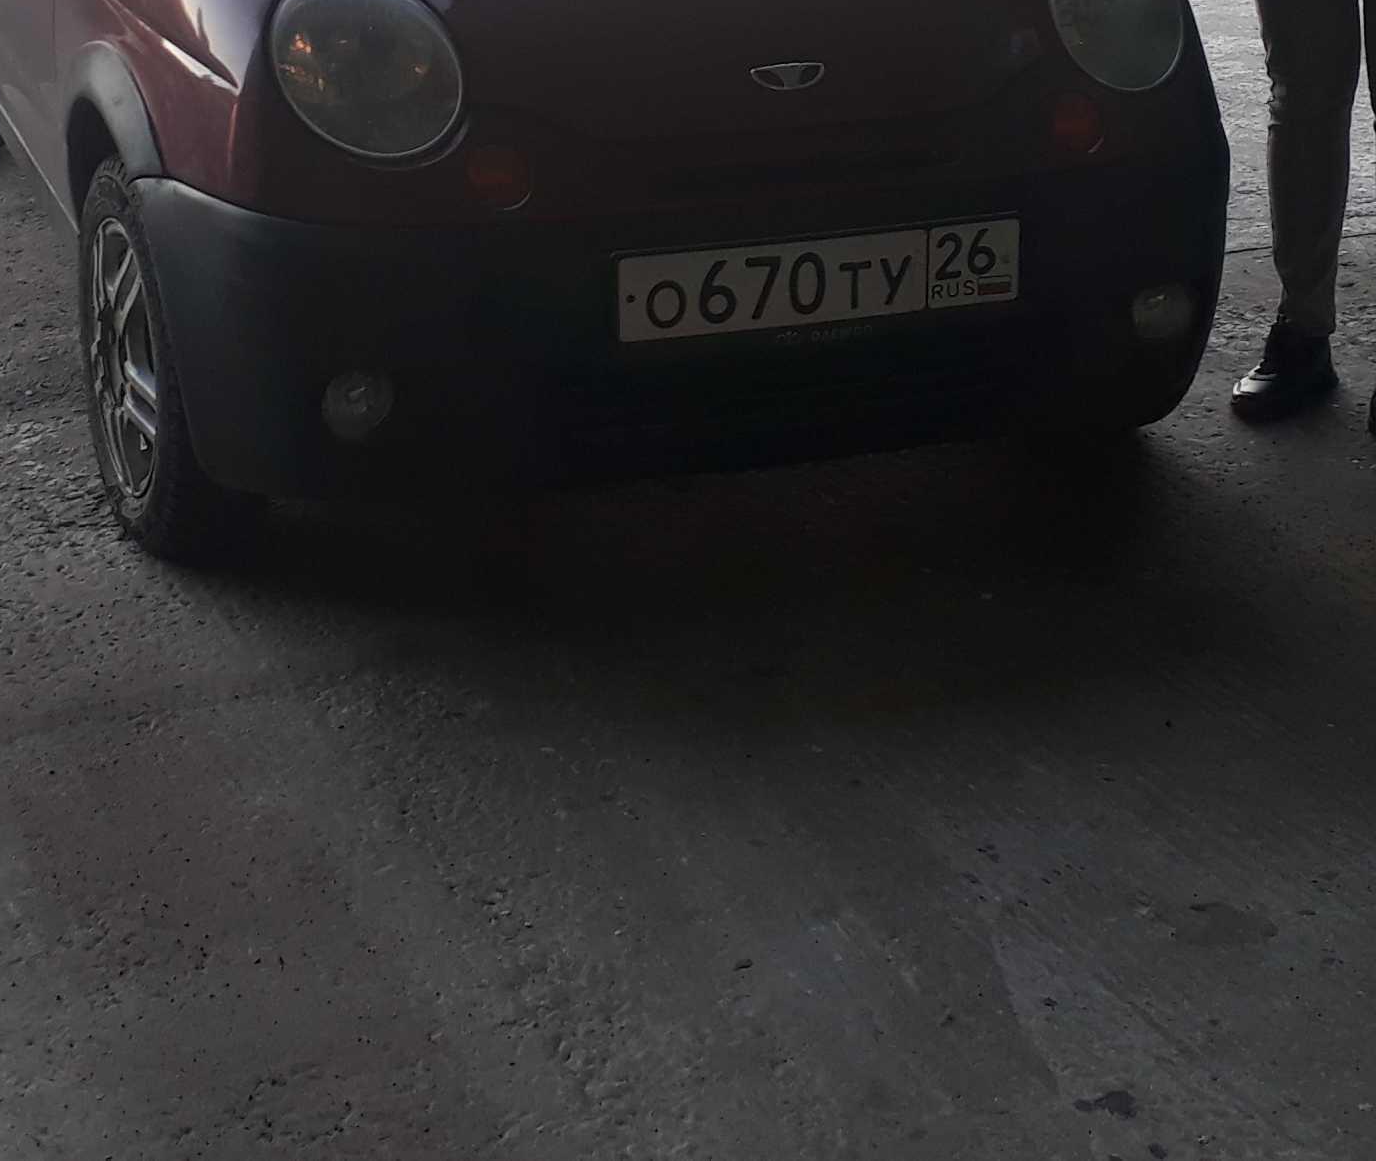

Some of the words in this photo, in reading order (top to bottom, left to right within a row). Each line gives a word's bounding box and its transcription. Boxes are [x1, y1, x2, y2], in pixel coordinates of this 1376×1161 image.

[645, 251, 913, 329] О670ТУ
[936, 228, 996, 280] 26
[931, 279, 976, 299] RUS
